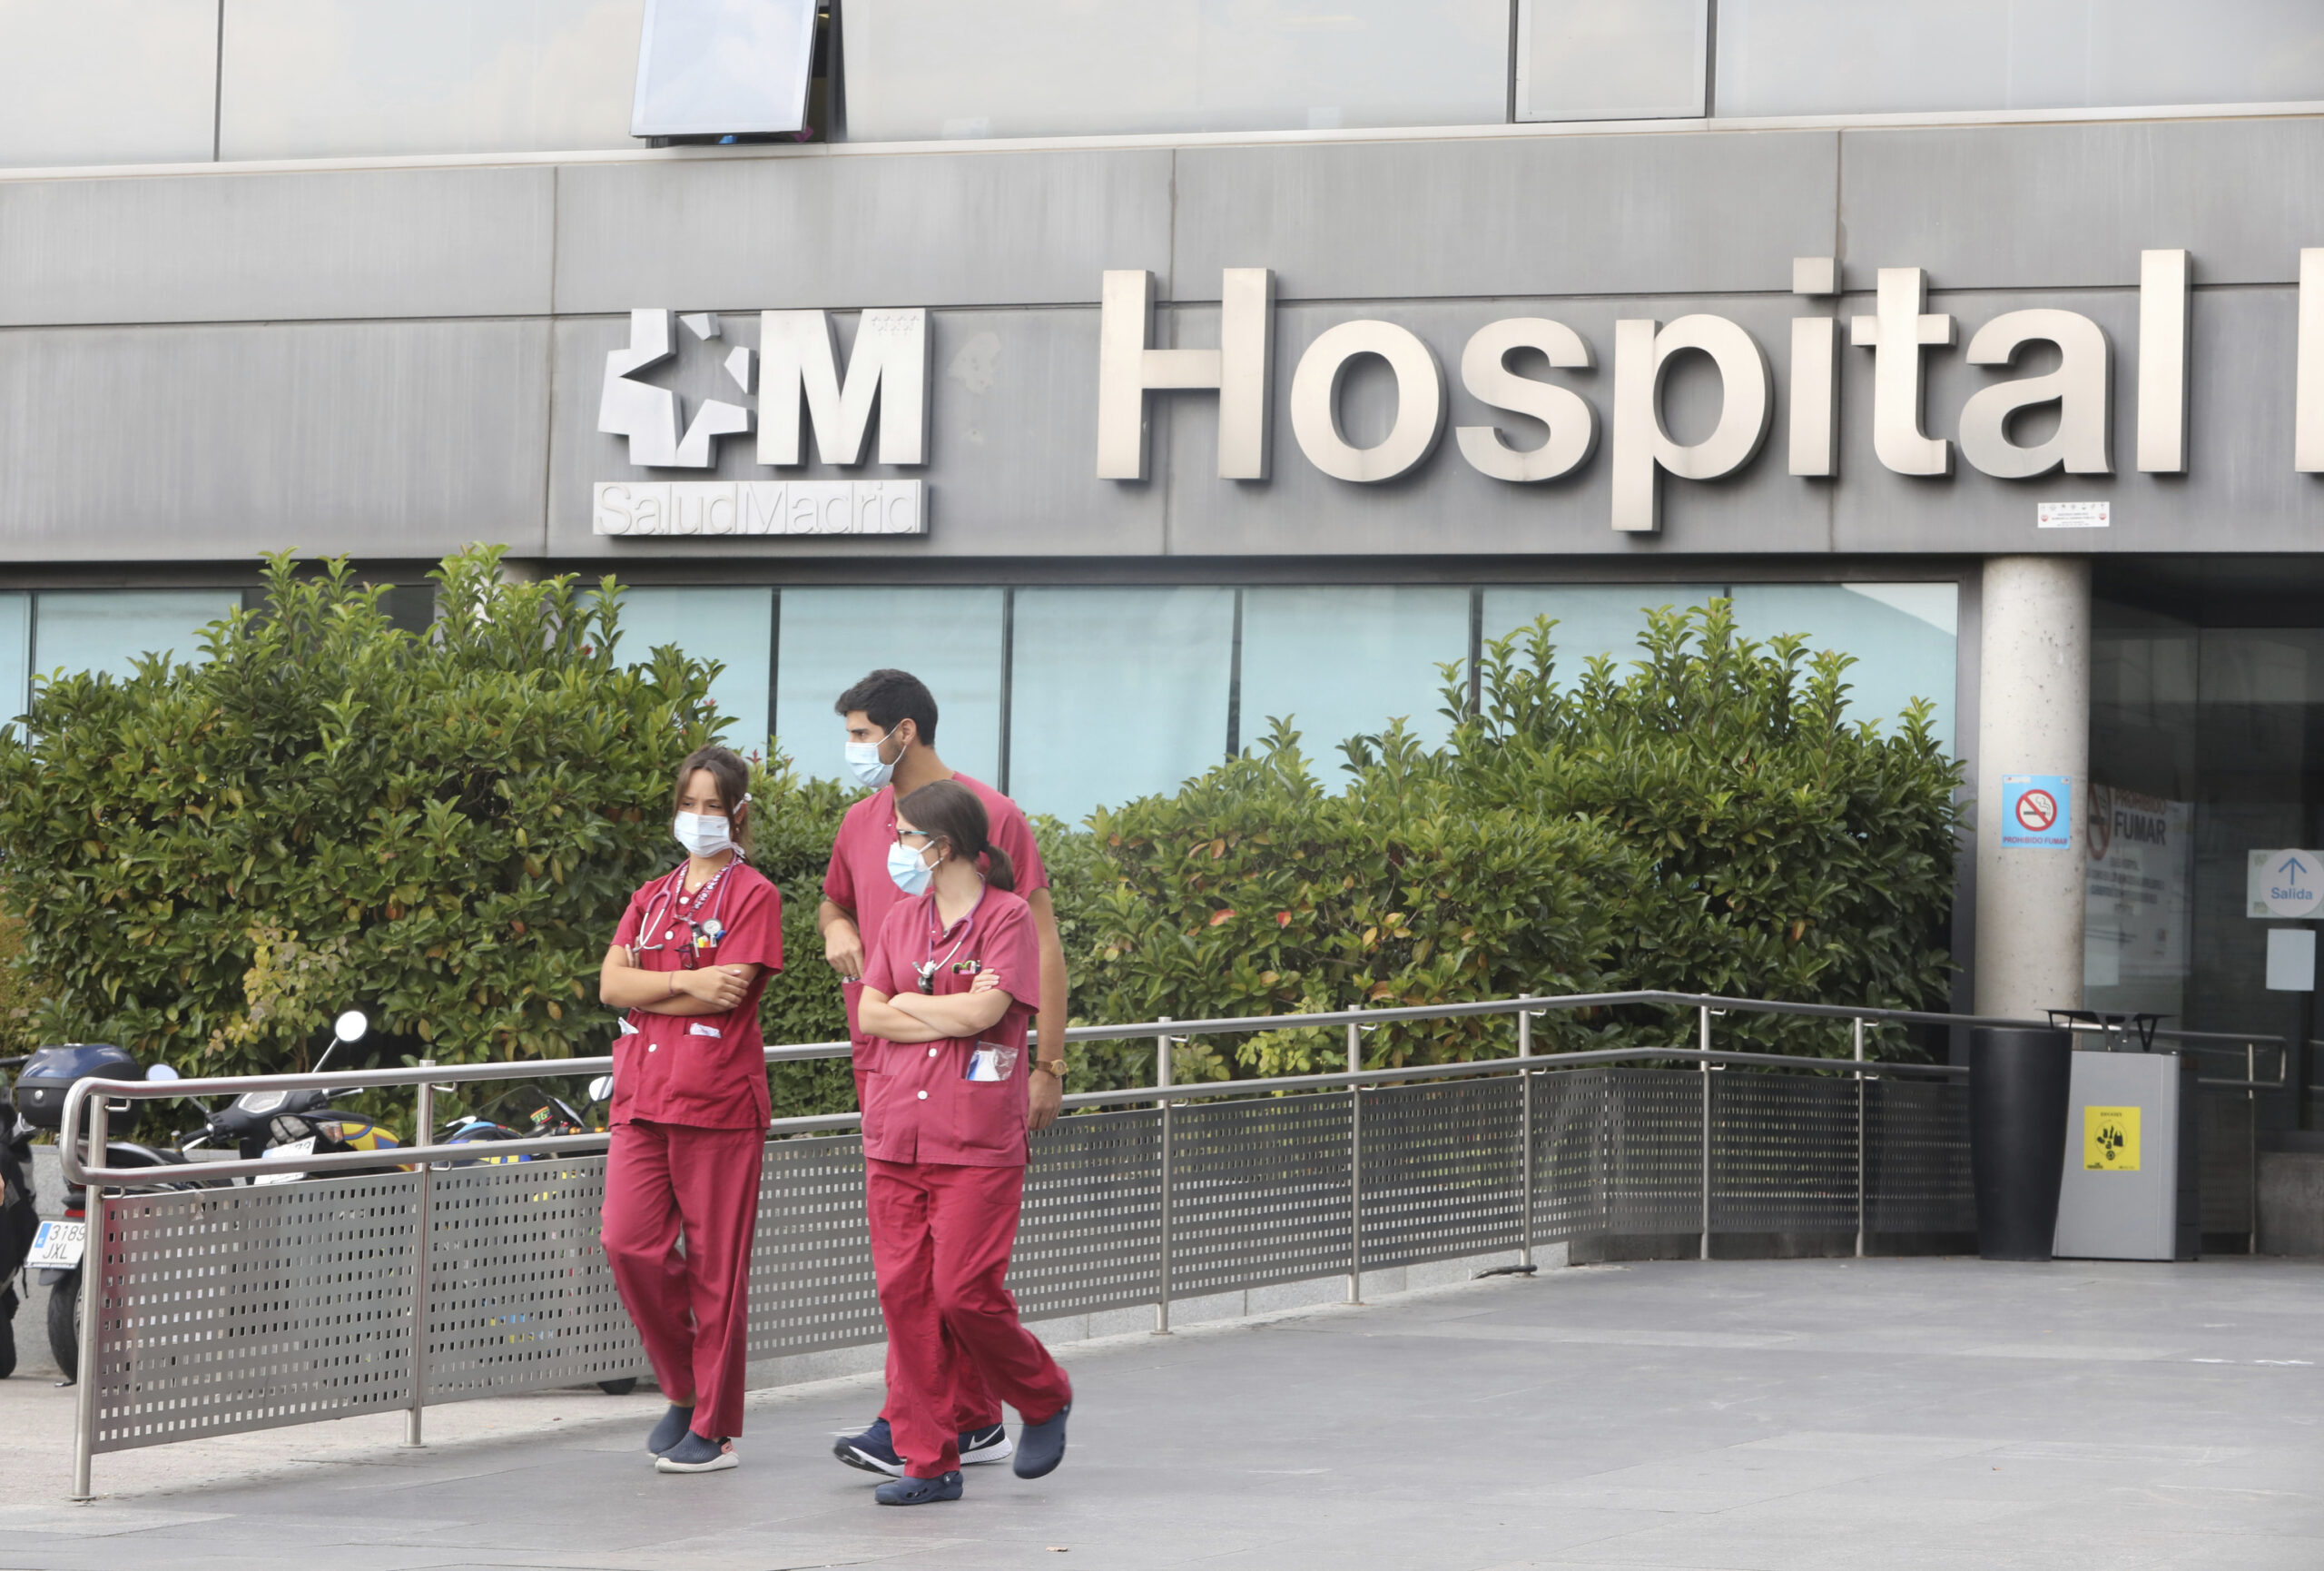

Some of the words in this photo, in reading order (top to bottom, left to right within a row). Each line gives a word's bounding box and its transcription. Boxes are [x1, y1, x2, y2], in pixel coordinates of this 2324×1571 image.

[757, 308, 931, 465] M
[1097, 248, 2190, 533] Hospital
[596, 481, 922, 534] SaludMadrid
[2003, 835, 2043, 845] PROHIBIDO
[2044, 836, 2067, 845] FUMAR
[2114, 810, 2166, 846] FUMAR
[2270, 886, 2313, 901] Salida
[49, 1224, 85, 1241] 3189
[43, 1243, 67, 1260] JXL
